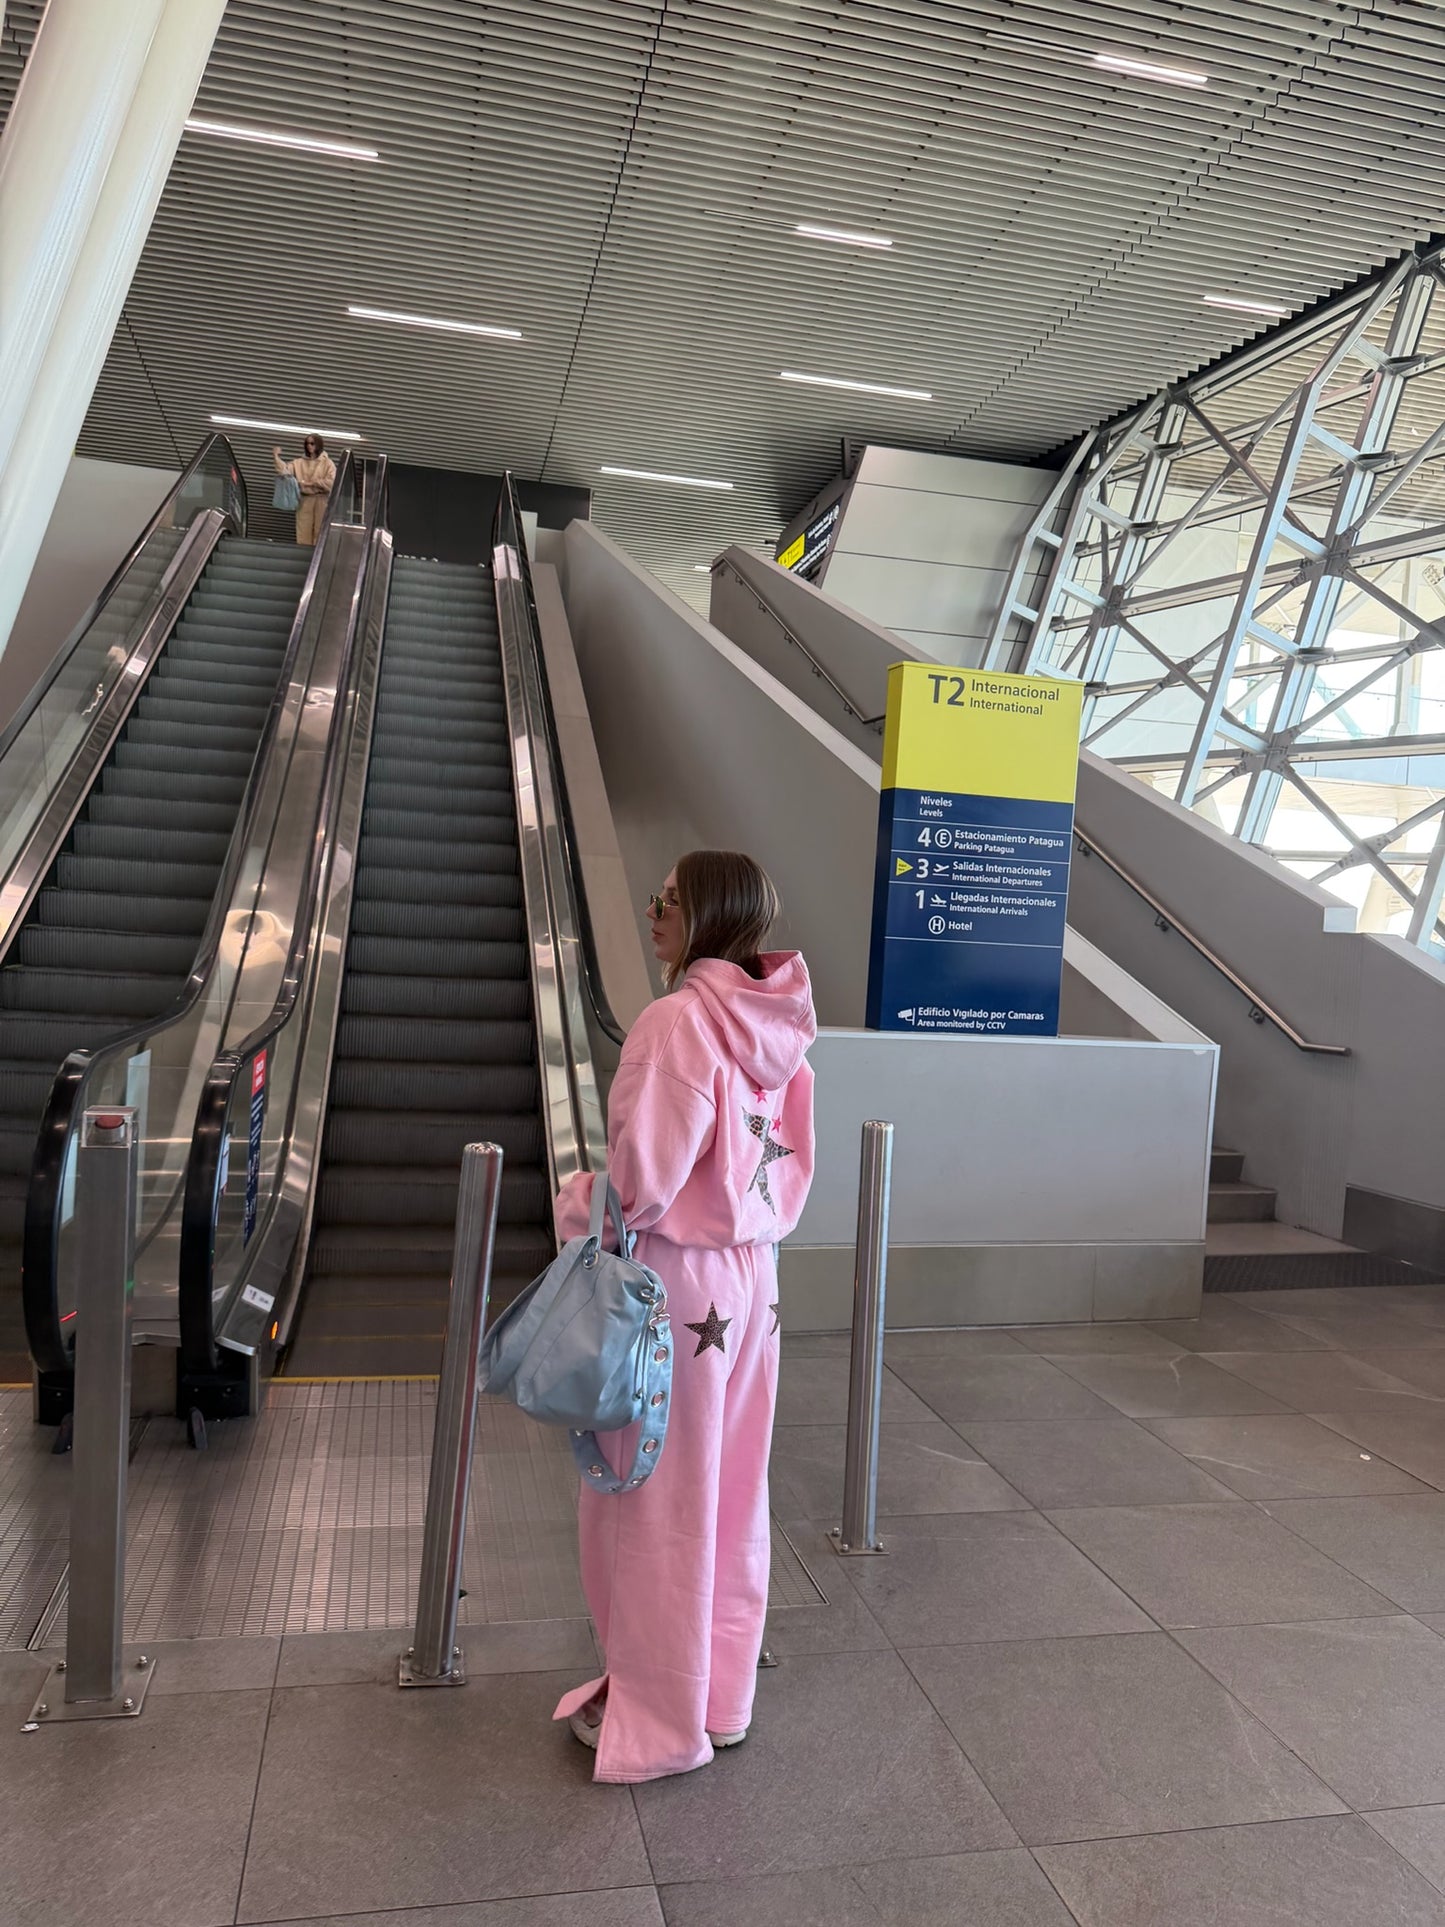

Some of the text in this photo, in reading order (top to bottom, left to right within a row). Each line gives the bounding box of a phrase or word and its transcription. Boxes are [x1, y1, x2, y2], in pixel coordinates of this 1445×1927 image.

[928, 674, 965, 706] T2
[972, 679, 1060, 701] Internacional
[970, 697, 1043, 716] International
[920, 796, 952, 808] Niveles
[919, 808, 944, 818] Levels
[917, 827, 932, 848] 4
[954, 830, 1027, 844] Estacionamiento
[1028, 836, 1064, 848] Patagua
[954, 842, 1015, 855] Parking Patagua
[916, 858, 929, 878] 3
[952, 860, 984, 872] Salidas
[986, 864, 1052, 876] Internacionales
[952, 872, 1042, 888] International Departures
[915, 890, 1056, 910] 1 Llegadas Internacionales
[950, 904, 1028, 916] International Arrivals
[948, 920, 973, 930] Hotel
[918, 1007, 1044, 1020] Edificio Vigilado por Camaras
[917, 1019, 1006, 1030] Area monitored by CCTV
